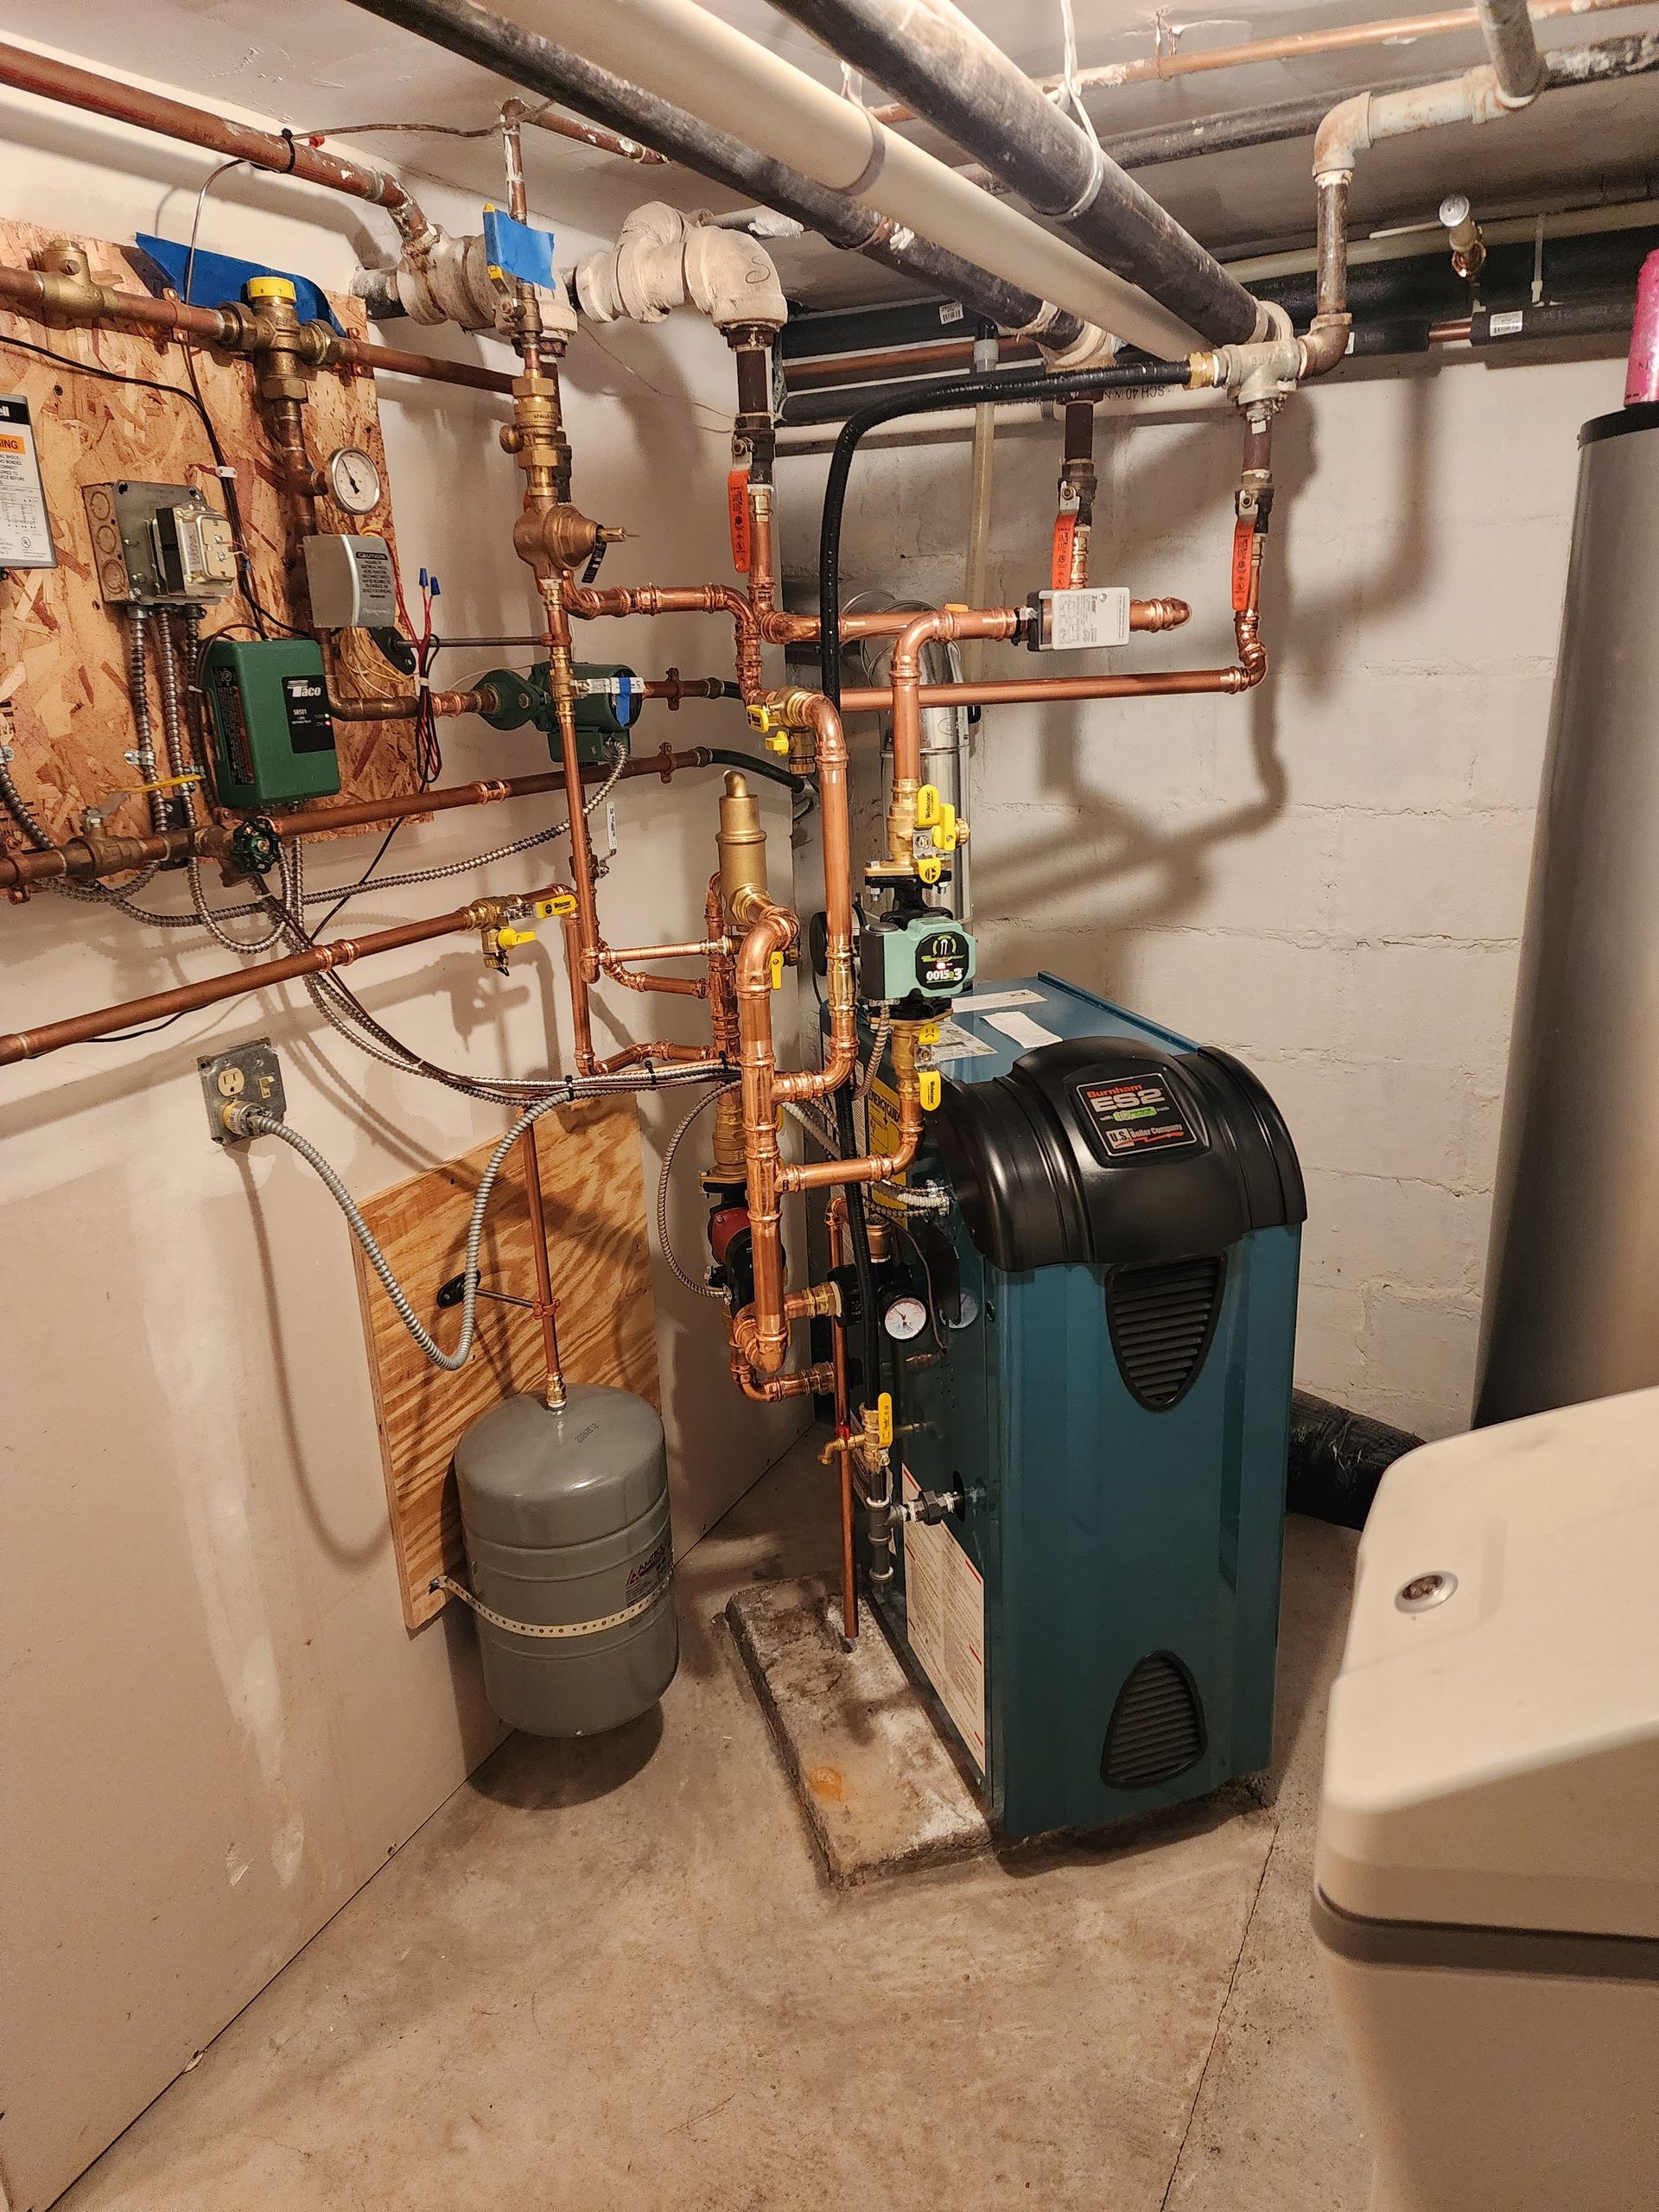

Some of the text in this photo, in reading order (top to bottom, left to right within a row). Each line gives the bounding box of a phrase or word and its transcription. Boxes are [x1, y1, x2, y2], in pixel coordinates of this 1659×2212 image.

[1125, 386, 1139, 400] 40
[1141, 385, 1165, 400] SCH
[287, 680, 321, 697] Taco
[1086, 1084, 1144, 1099] Burnham
[868, 1090, 899, 1123] ENERGYGUID
[1090, 1088, 1166, 1113] ES2
[1109, 1123, 1183, 1142] U.S. Boiler Company
